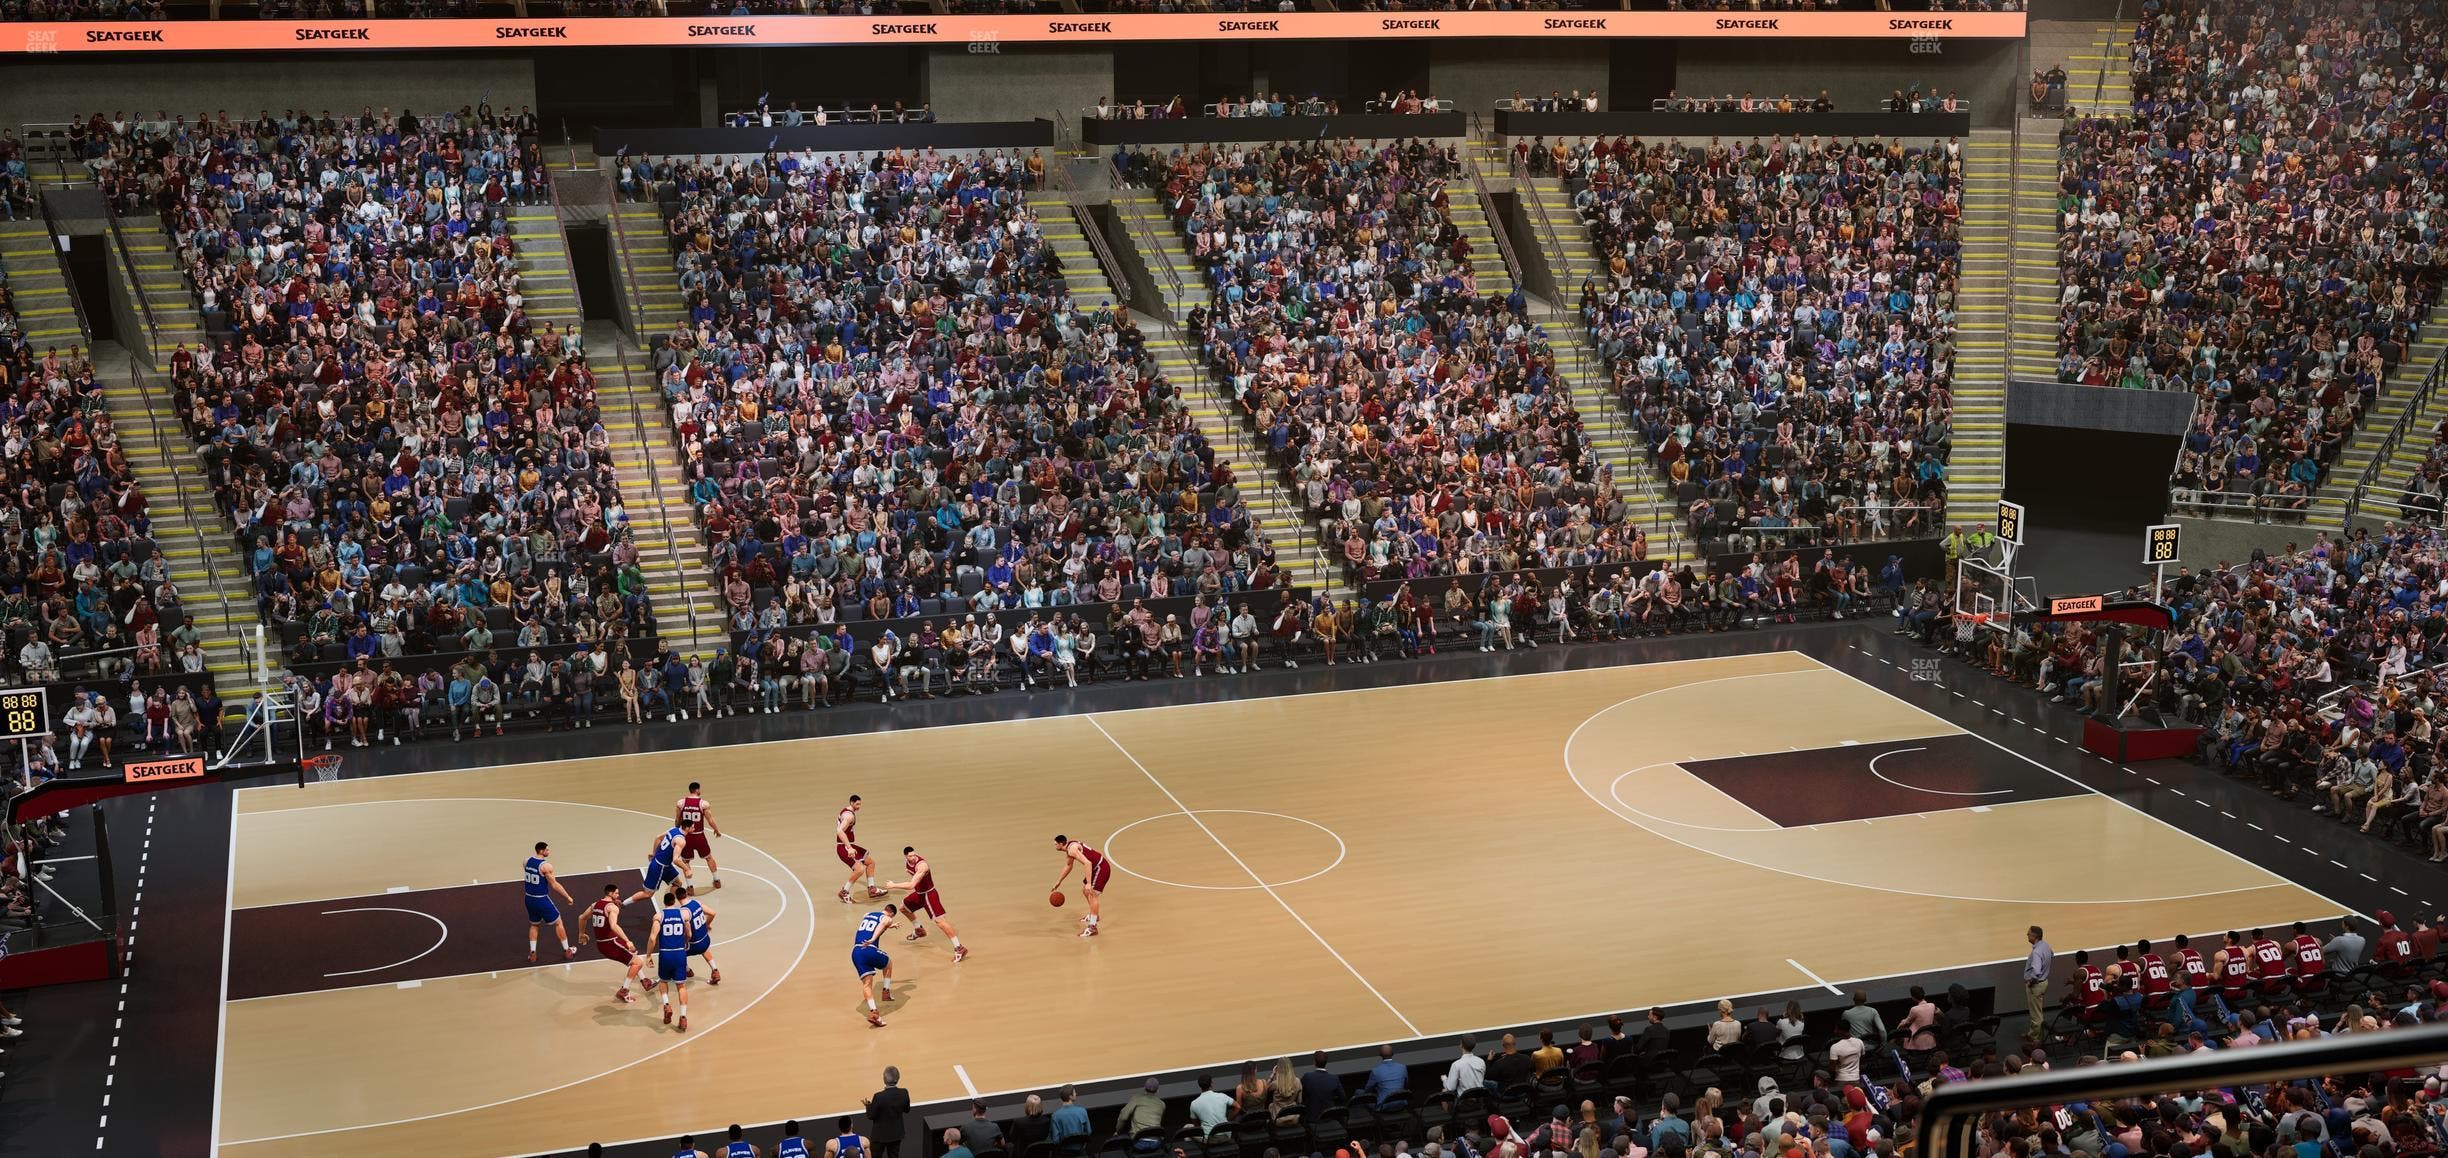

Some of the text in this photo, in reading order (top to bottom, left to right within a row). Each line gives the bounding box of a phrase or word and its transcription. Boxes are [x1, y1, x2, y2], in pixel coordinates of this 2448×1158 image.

[688, 24, 755, 37] SEATGEEK
[872, 23, 937, 35] SEATGEEK
[1049, 21, 1111, 34] SEATGEEK
[1219, 20, 1279, 32] SEATGEEK
[1383, 18, 1440, 31] SEATGEEK
[1545, 18, 1606, 30] SEATGEEK
[1716, 18, 1778, 30] SEATGEEK
[1889, 19, 1952, 31] SEATGEEK
[87, 29, 163, 43] SEATGEEK
[296, 27, 370, 41] SEATGEEK
[496, 26, 567, 39] SEATGEEK
[2155, 542, 2172, 559] 88
[2057, 599, 2096, 612] SEATGEEK
[2, 694, 37, 709] 88 88
[8, 710, 36, 732] 88
[133, 762, 197, 778] SEATGEEK
[663, 923, 683, 936] 00
[858, 919, 877, 932] 00
[2258, 947, 2282, 963] 00
[2300, 949, 2322, 962] 00
[2148, 966, 2168, 979] 00
[2186, 961, 2206, 974] 00
[2228, 962, 2246, 975] 00
